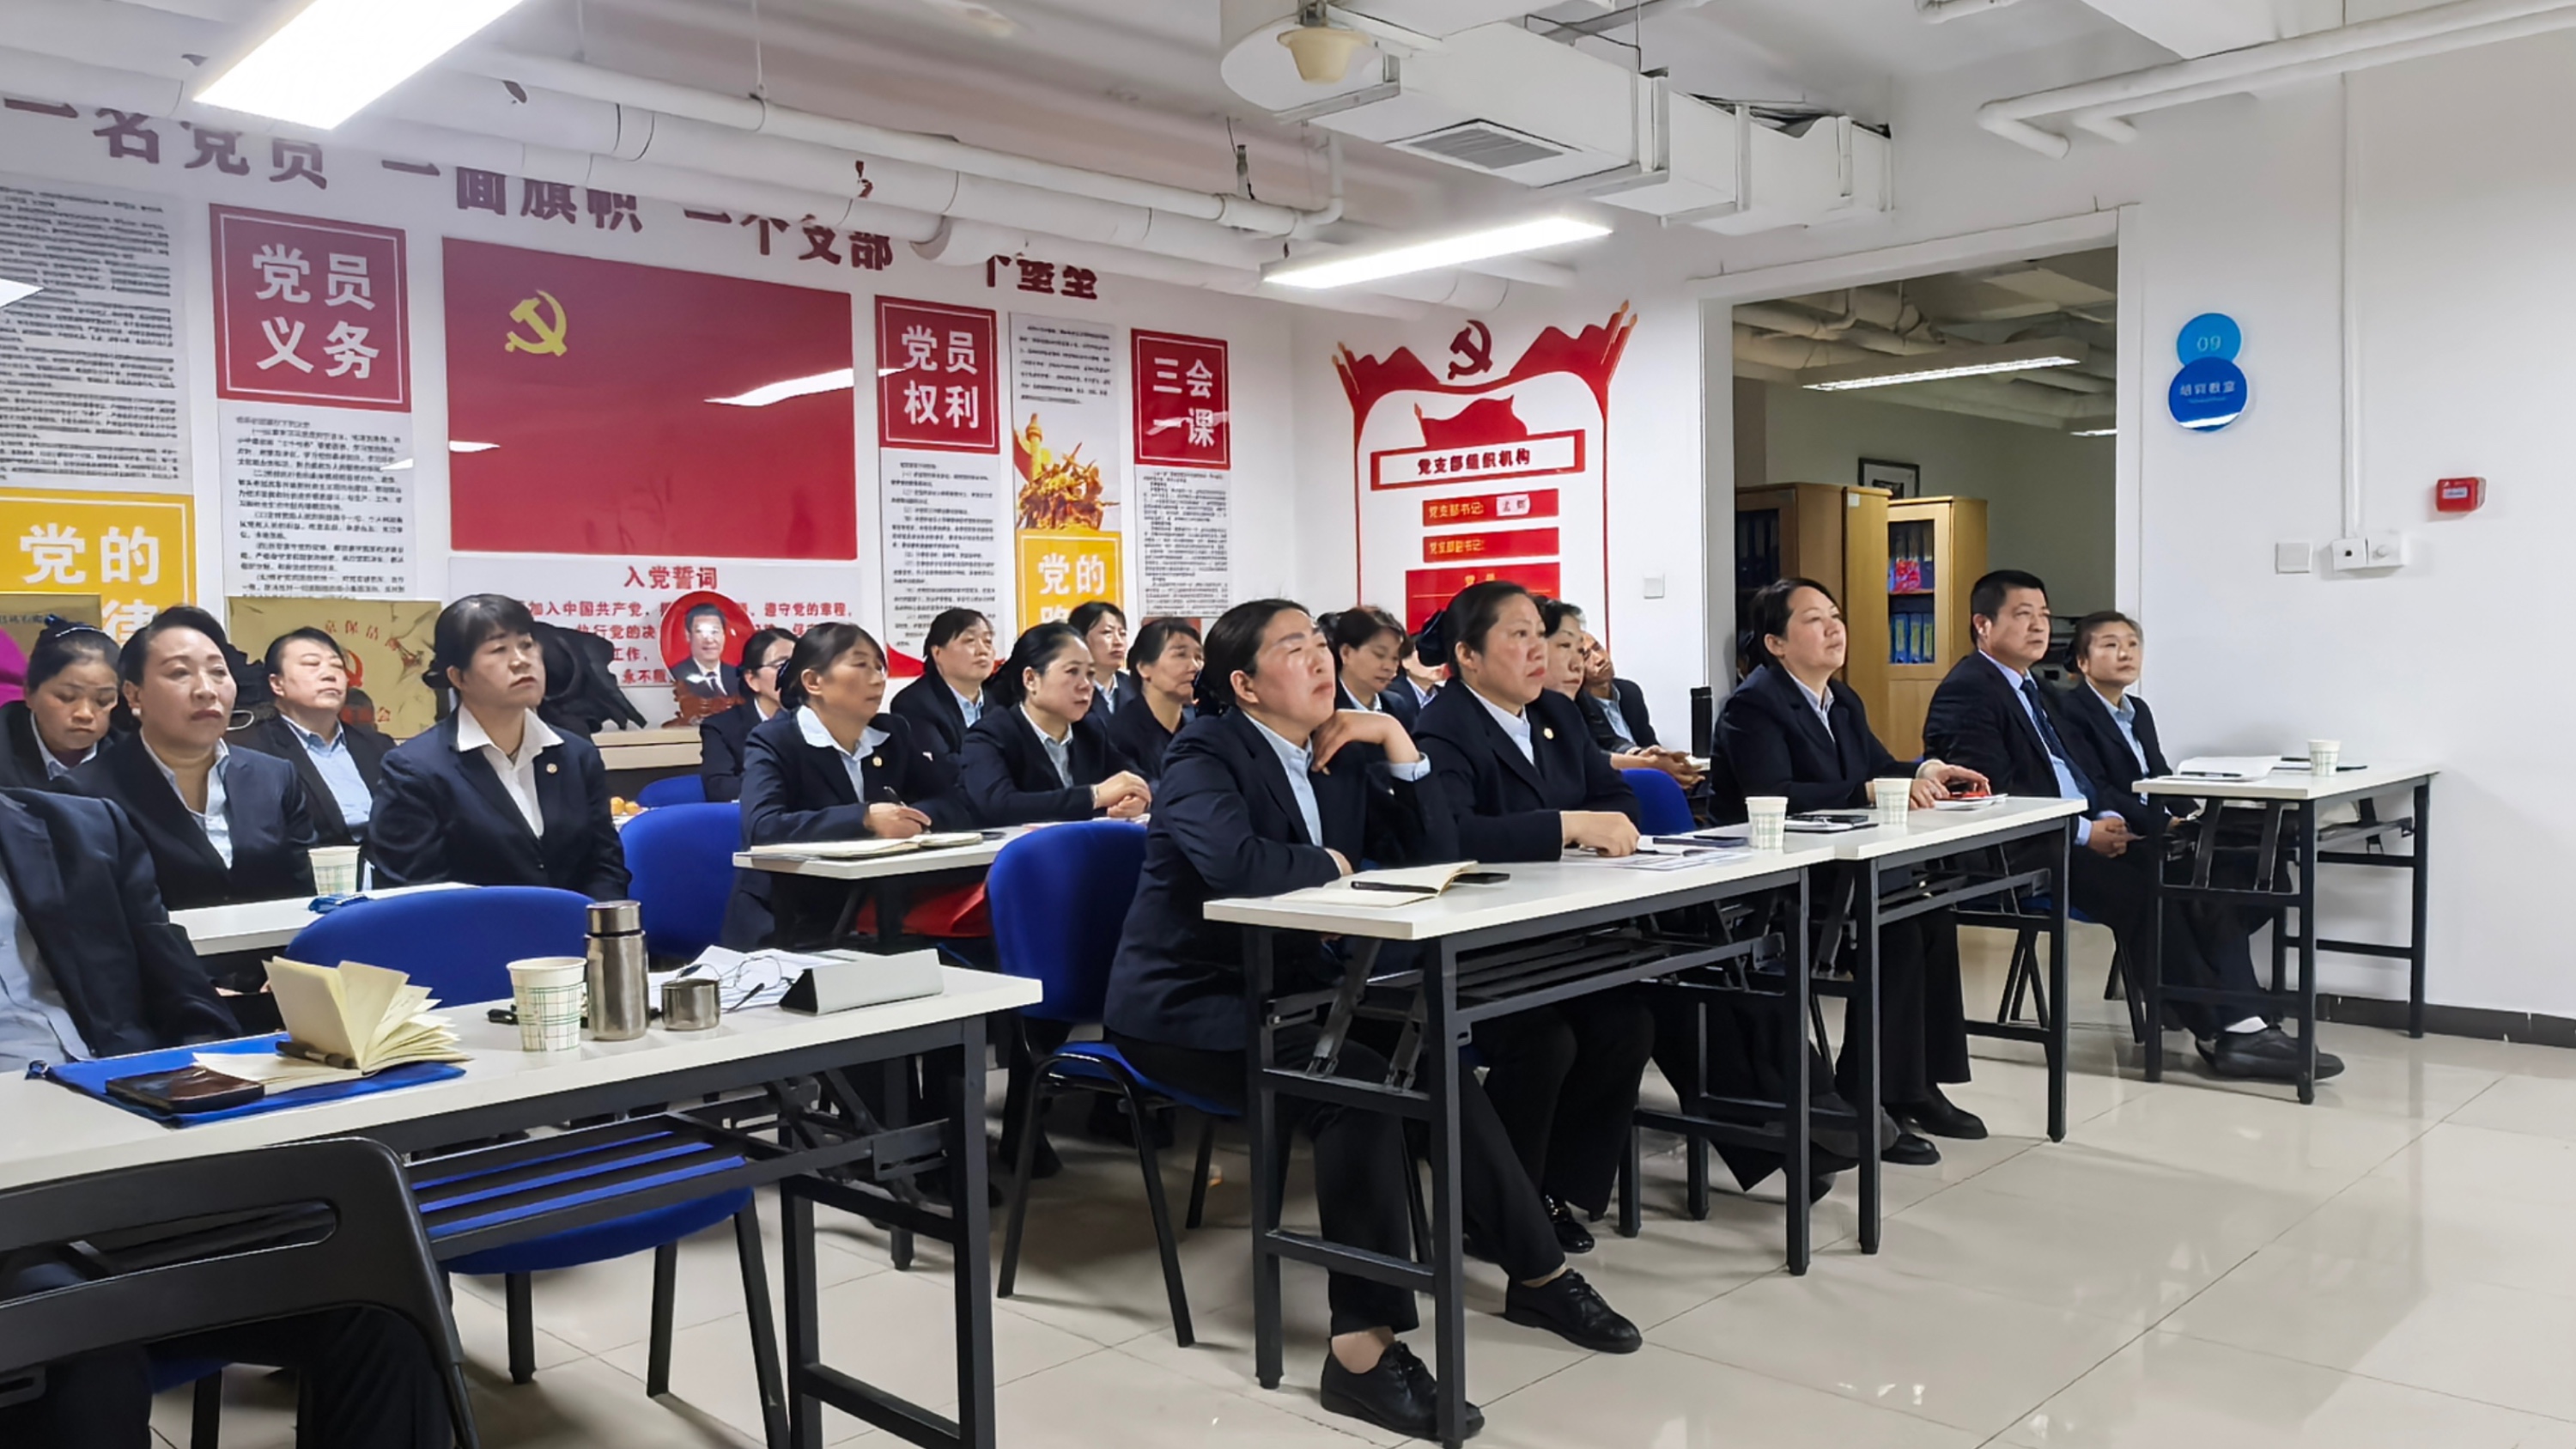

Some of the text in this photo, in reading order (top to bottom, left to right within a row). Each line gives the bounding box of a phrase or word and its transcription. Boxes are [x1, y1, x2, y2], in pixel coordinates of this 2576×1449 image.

[252, 244, 375, 310] 党员
[257, 317, 379, 379] 义务
[902, 325, 978, 374] 党员
[2196, 335, 2222, 352] 09
[1153, 357, 1213, 399] 三会
[903, 380, 979, 429] 权利
[1153, 407, 1215, 447] 一课
[1418, 447, 1531, 476] 党支部组织机构
[20, 522, 160, 586] 党的
[1037, 552, 1105, 595] 党的
[623, 565, 718, 590] 入党誓词
